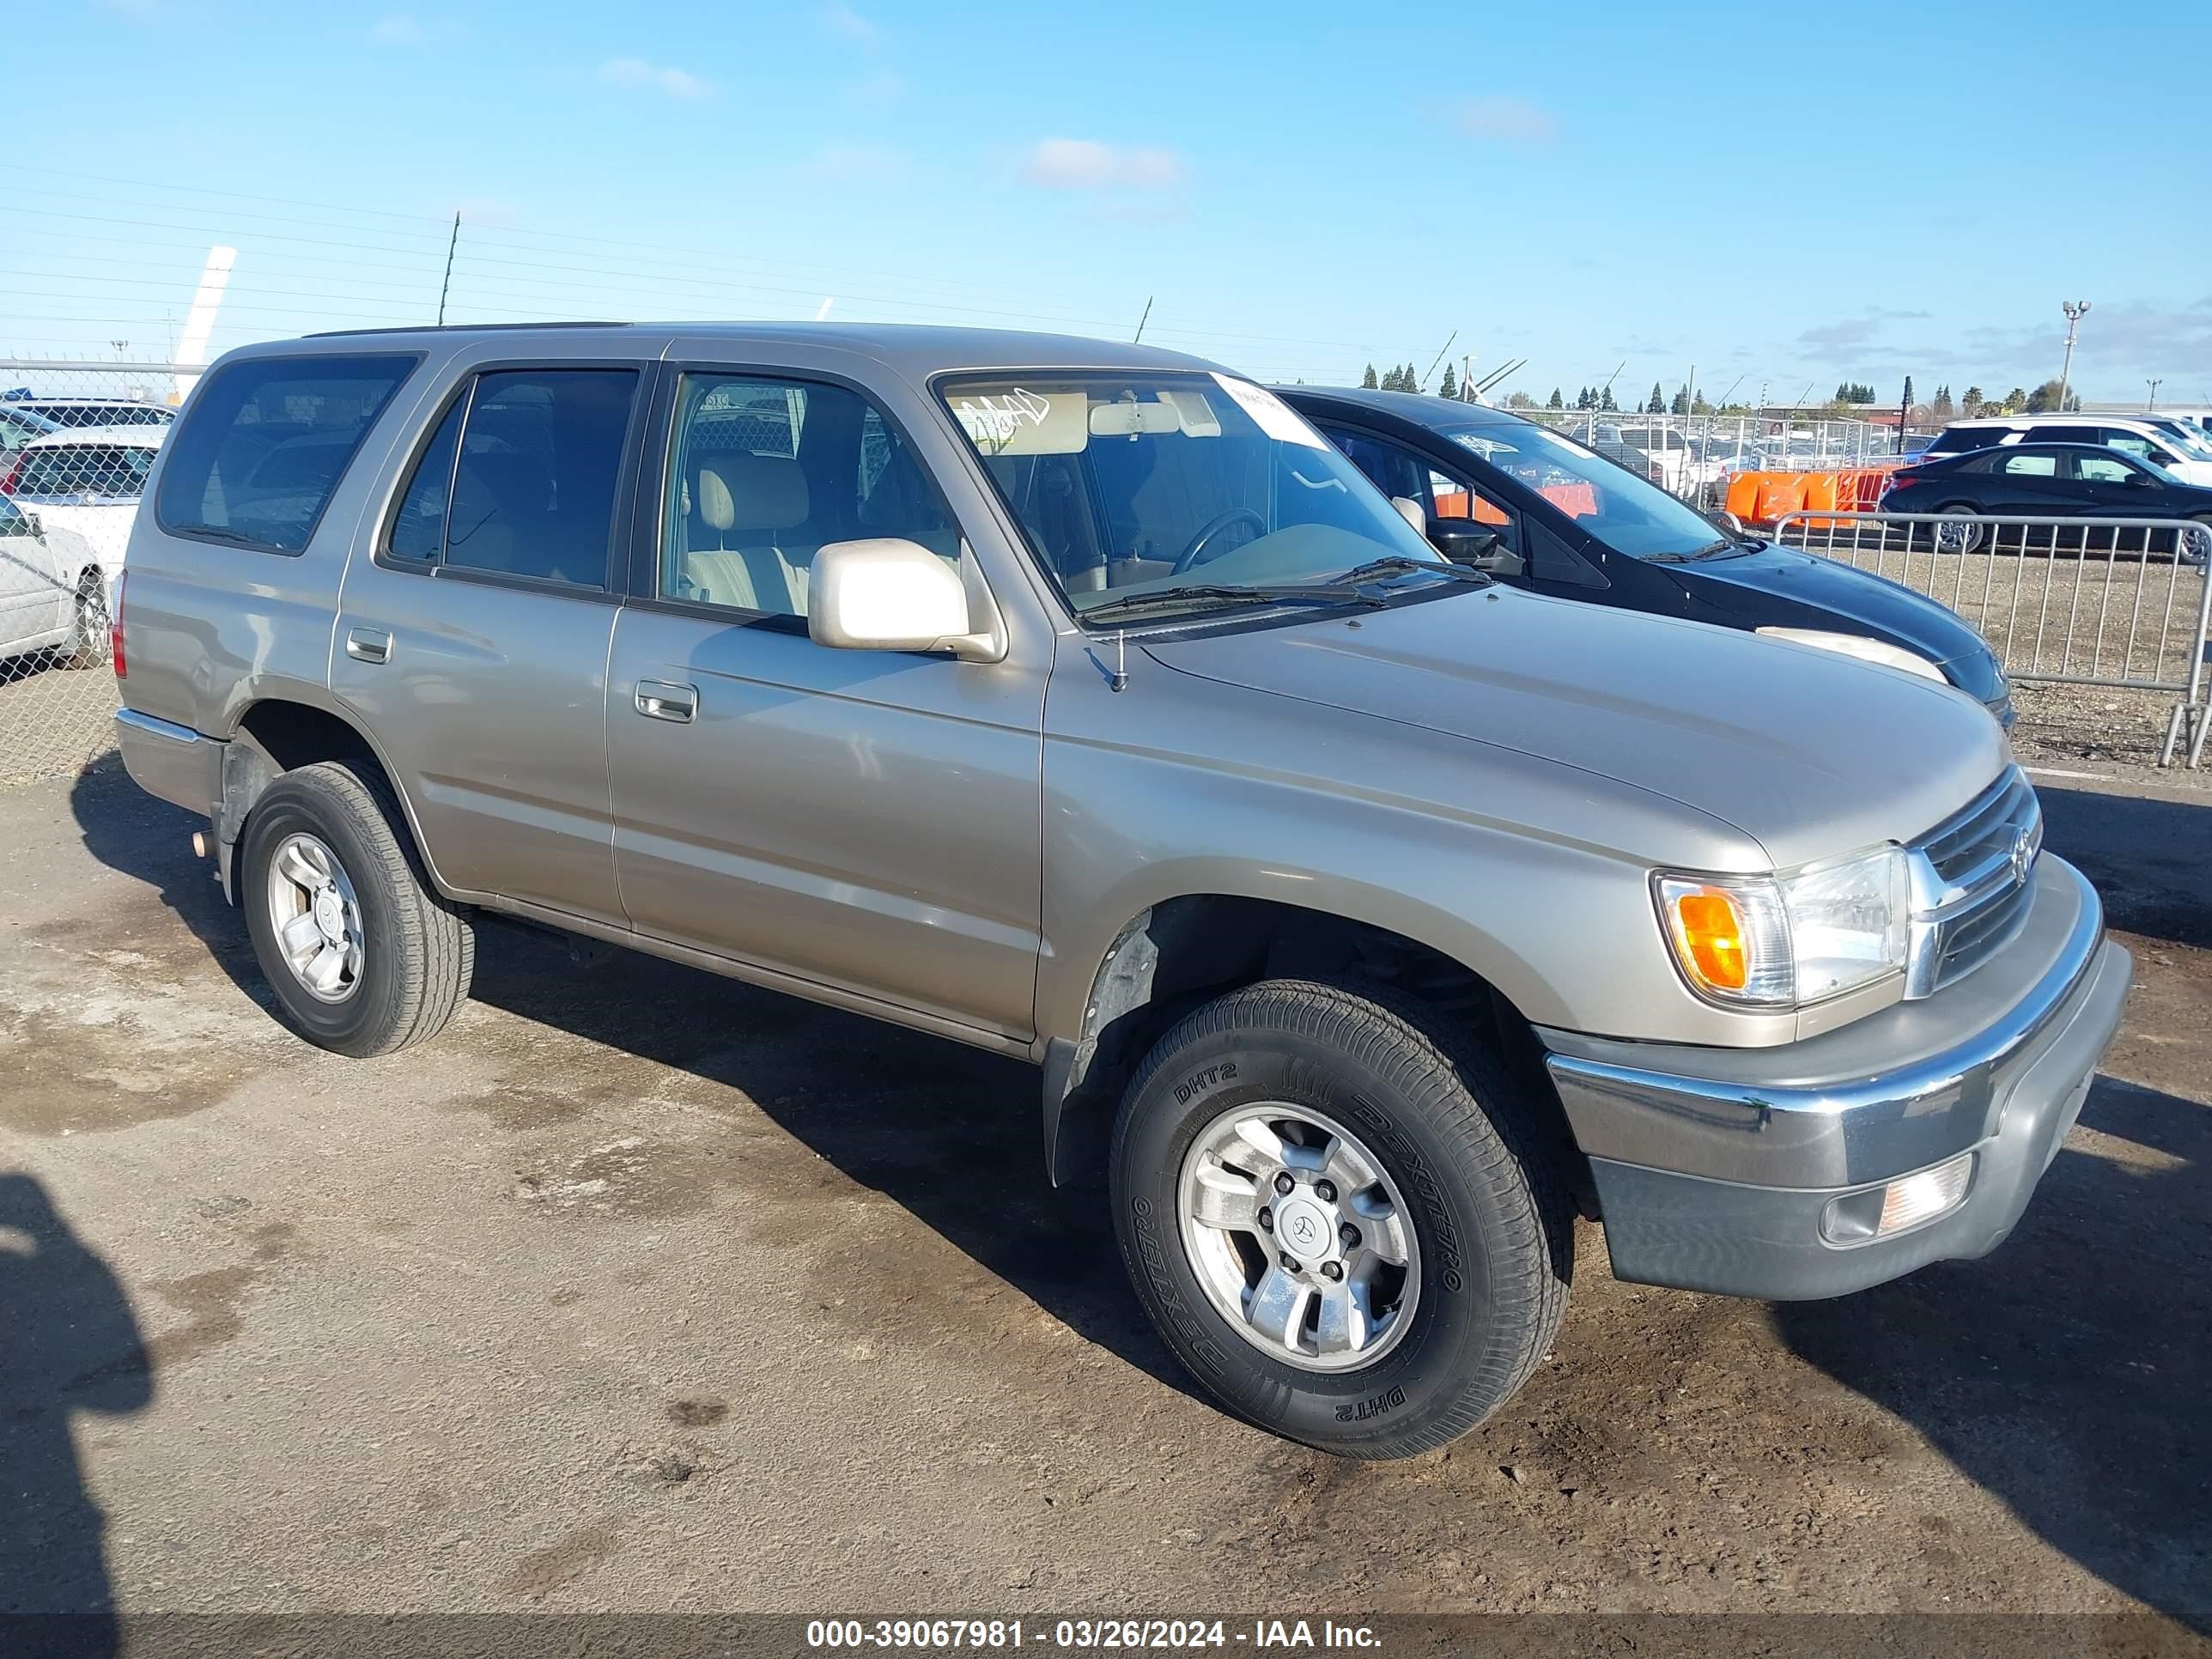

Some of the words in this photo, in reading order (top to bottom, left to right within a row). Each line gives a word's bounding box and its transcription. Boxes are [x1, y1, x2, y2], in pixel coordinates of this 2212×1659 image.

[1174, 1062, 1239, 1105] DHT2
[1352, 1093, 1463, 1292] DEXTERO
[1133, 1195, 1229, 1376] DEXTERO
[1334, 1385, 1408, 1423] DHT2
